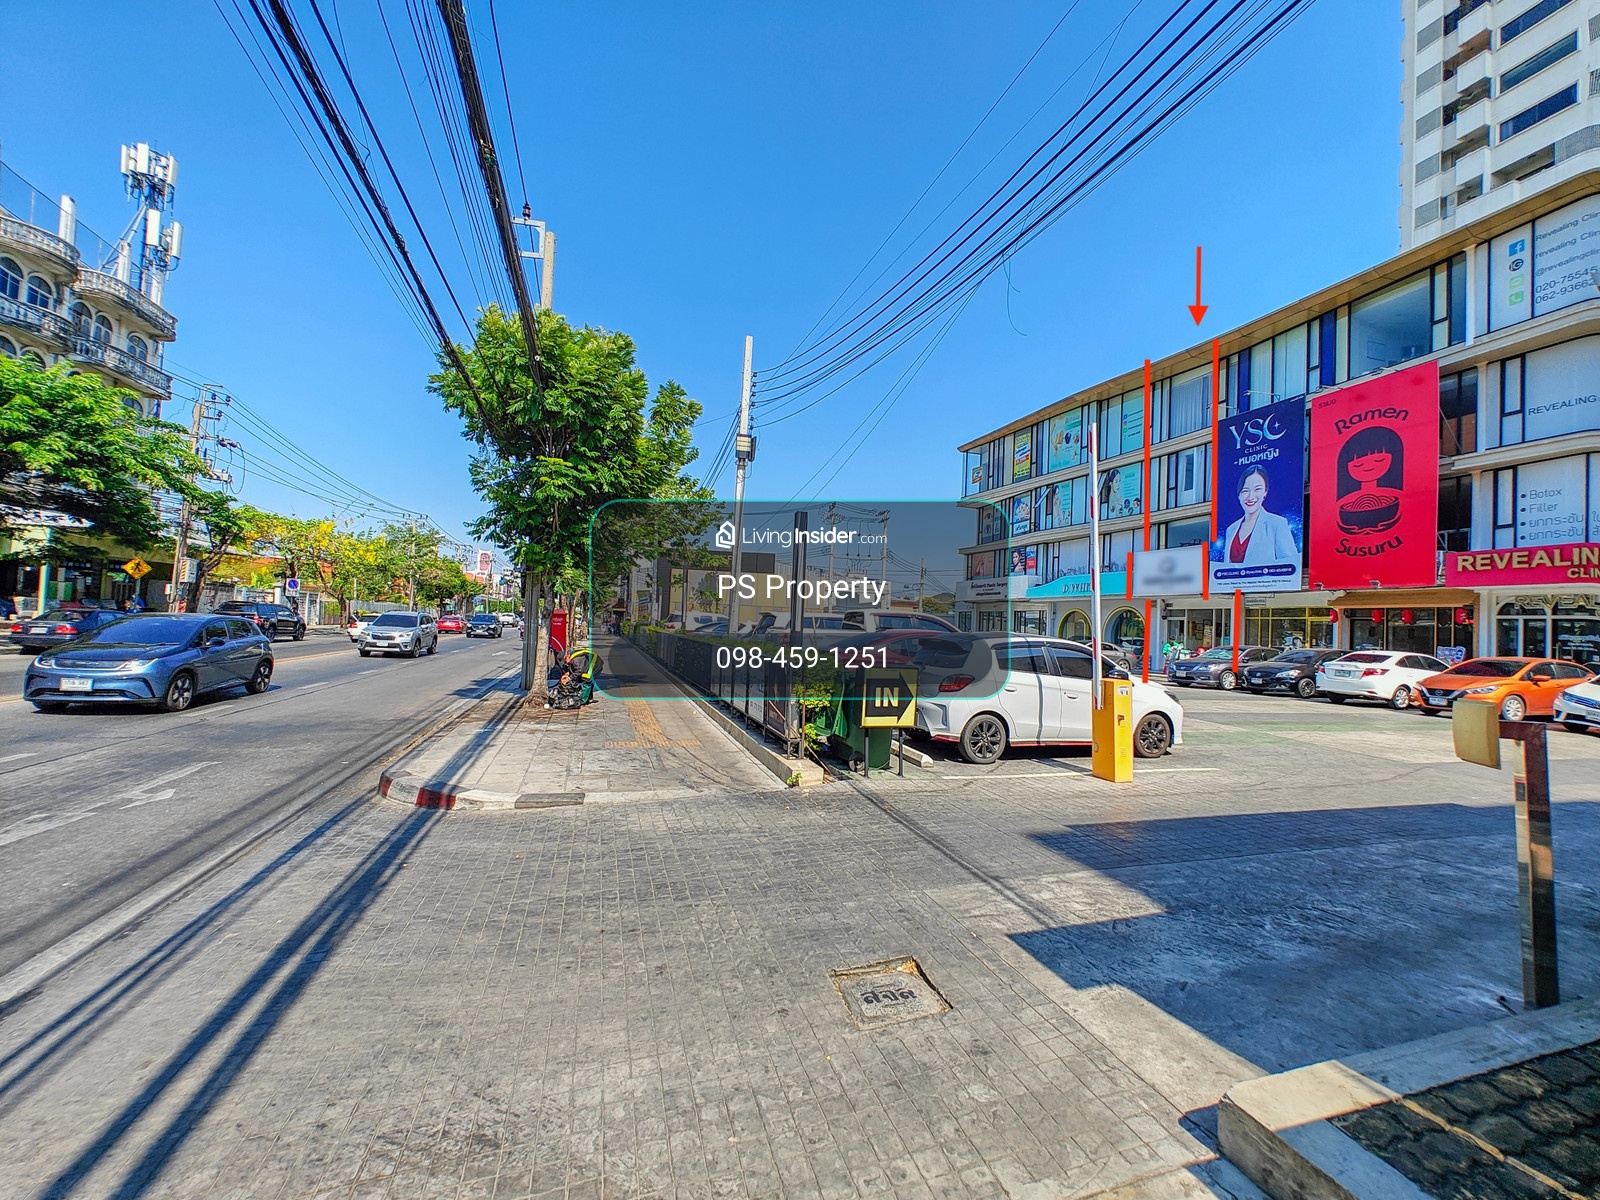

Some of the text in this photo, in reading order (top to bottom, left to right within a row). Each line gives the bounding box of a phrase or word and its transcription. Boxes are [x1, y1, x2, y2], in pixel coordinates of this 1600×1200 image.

[1536, 220, 1579, 241] Revealing
[1536, 238, 1577, 259] revealing
[1528, 394, 1597, 416] REVEALING
[1229, 413, 1287, 449] YSC
[1334, 407, 1409, 435] Ramen
[1244, 443, 1268, 454] CLINIC
[1529, 488, 1562, 500] Botox
[1529, 503, 1558, 514] Filler
[1529, 513, 1584, 528] ยกกระชับ
[1529, 526, 1584, 541] ยกกระชับ
[1335, 535, 1403, 557] Susuru
[874, 686, 900, 708] IN
